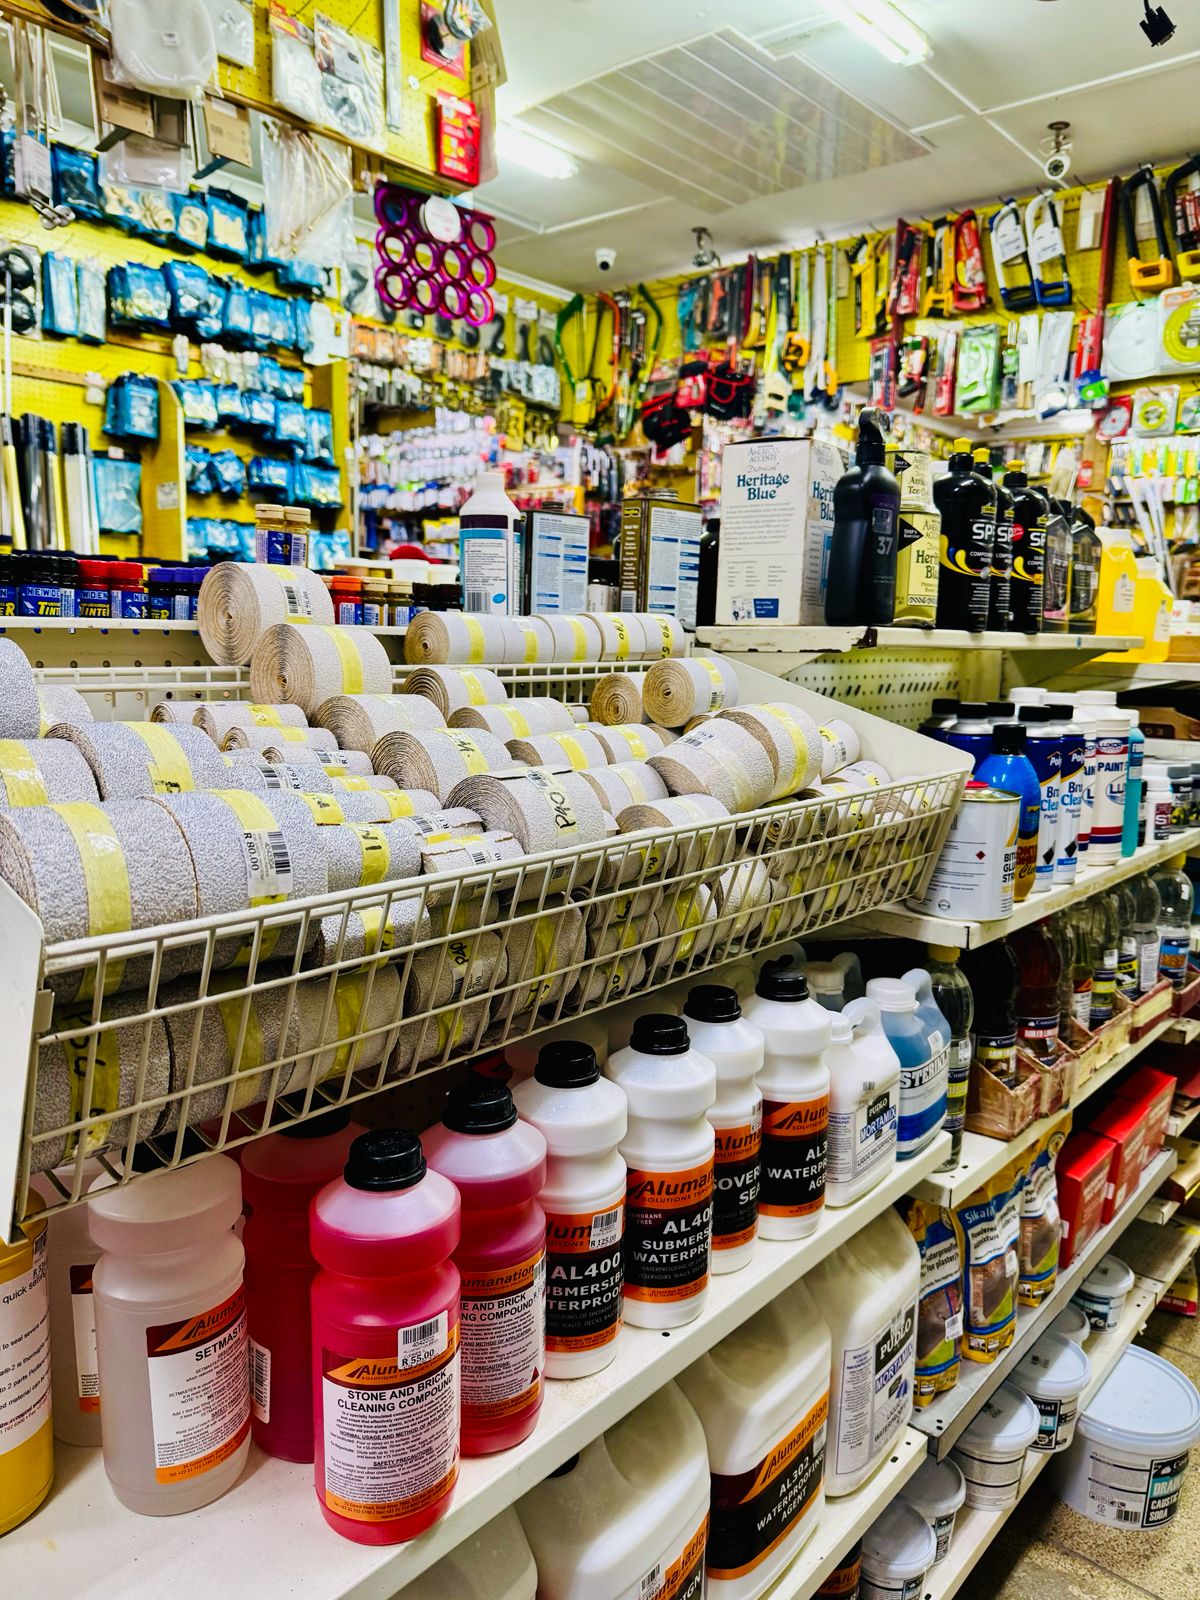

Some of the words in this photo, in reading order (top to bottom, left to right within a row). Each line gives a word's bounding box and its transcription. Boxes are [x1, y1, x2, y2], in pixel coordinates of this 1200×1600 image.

[737, 473, 790, 488] Heritage
[747, 487, 777, 501] Blue
[877, 537, 894, 555] 37
[1097, 762, 1122, 772] PAINT
[244, 832, 253, 840] R
[246, 841, 260, 871] 80.00
[868, 1098, 888, 1117] PUDLO
[860, 1106, 897, 1143] MORTAMIX
[590, 1240, 596, 1248] R
[551, 1251, 621, 1281] AL400
[471, 1302, 495, 1311] AND
[497, 1292, 527, 1308] BRICK
[479, 1298, 533, 1323] COMPOUND
[880, 1317, 912, 1360] PUDLO
[401, 1358, 409, 1367] R
[410, 1348, 436, 1365] 55.00
[337, 1398, 396, 1413] CLEANING
[398, 1373, 454, 1410] COMPOUND
[347, 1389, 387, 1402] STONE
[389, 1386, 415, 1401] AND
[417, 1369, 447, 1393] BRICK
[770, 1400, 828, 1467] Alumanation
[373, 1459, 395, 1467] SAFETY
[779, 1456, 810, 1498] AL302
[757, 1449, 824, 1531] WATERPROOFING
[781, 1485, 808, 1522] AGENT
[1149, 1508, 1169, 1522] SODA
